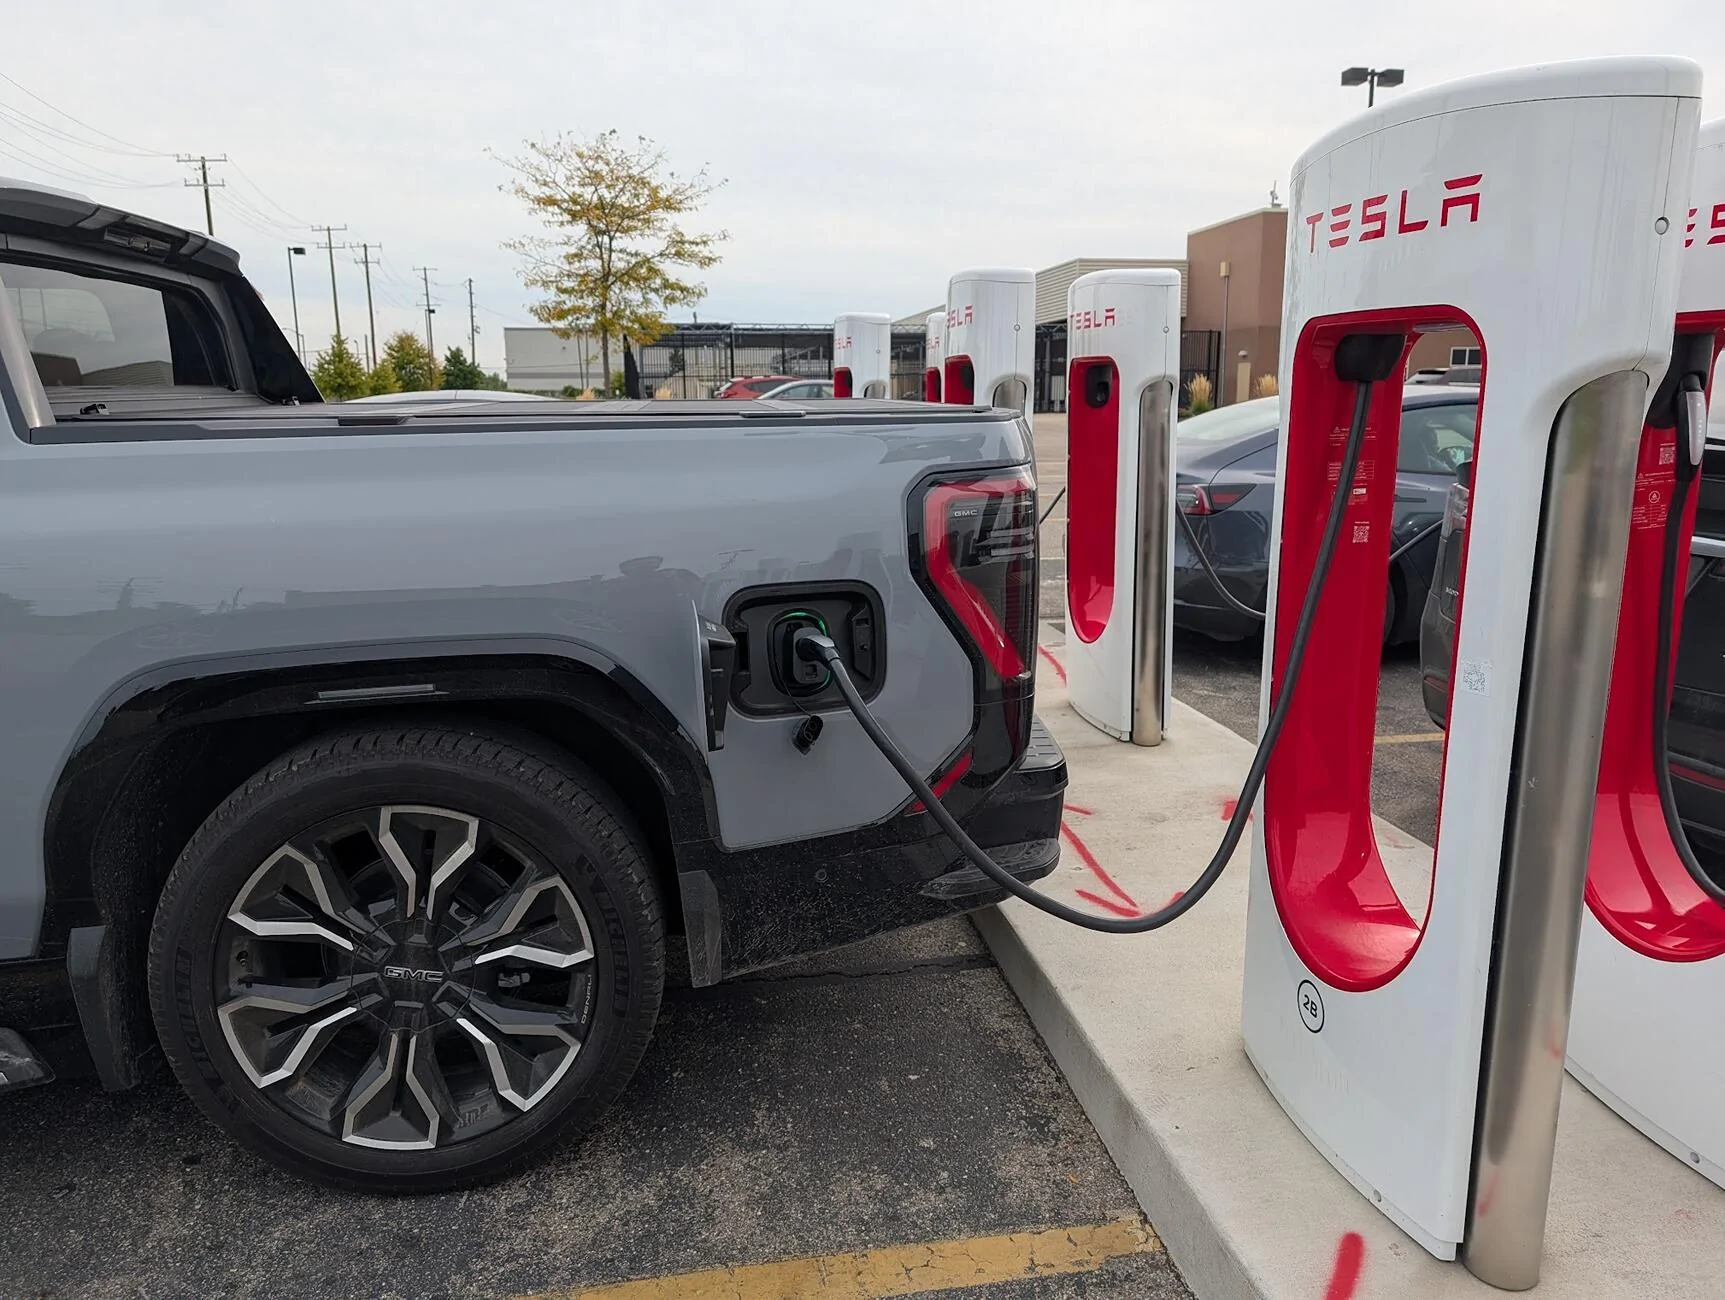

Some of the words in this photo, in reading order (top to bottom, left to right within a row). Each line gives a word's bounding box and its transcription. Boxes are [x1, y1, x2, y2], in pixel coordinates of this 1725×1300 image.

[1306, 173, 1484, 253] TESLA
[1070, 308, 1116, 330] TESLA
[954, 509, 978, 517] GMC
[384, 965, 444, 983] GMC
[580, 973, 592, 1025] DENALI
[1303, 993, 1318, 1018] 2B
